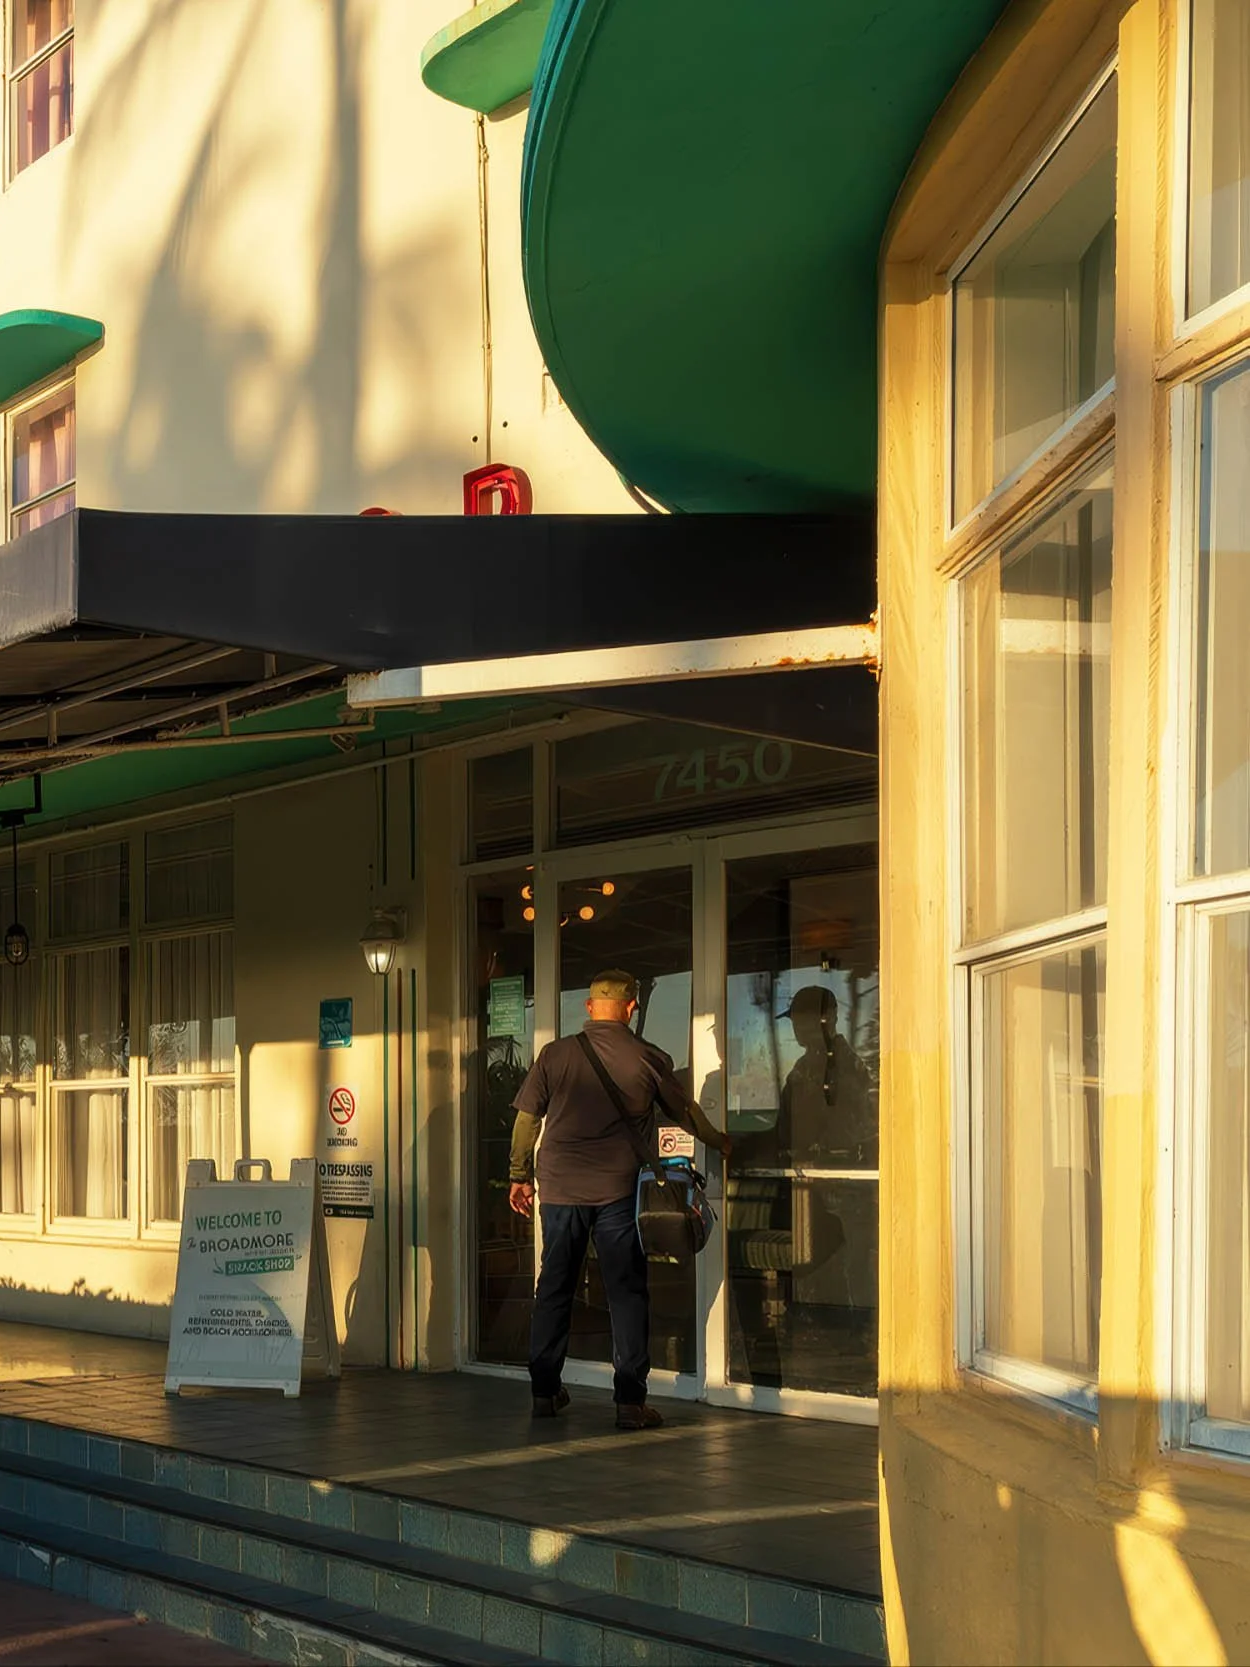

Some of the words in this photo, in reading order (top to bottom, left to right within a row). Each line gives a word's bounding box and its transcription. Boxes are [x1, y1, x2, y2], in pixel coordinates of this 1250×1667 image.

[652, 740, 792, 803] 7450
[195, 1211, 261, 1231] WELCOME
[264, 1210, 282, 1226] TO
[199, 1232, 294, 1253] BROADMORE
[264, 1258, 292, 1270] SHOP
[210, 1308, 234, 1317] COLD
